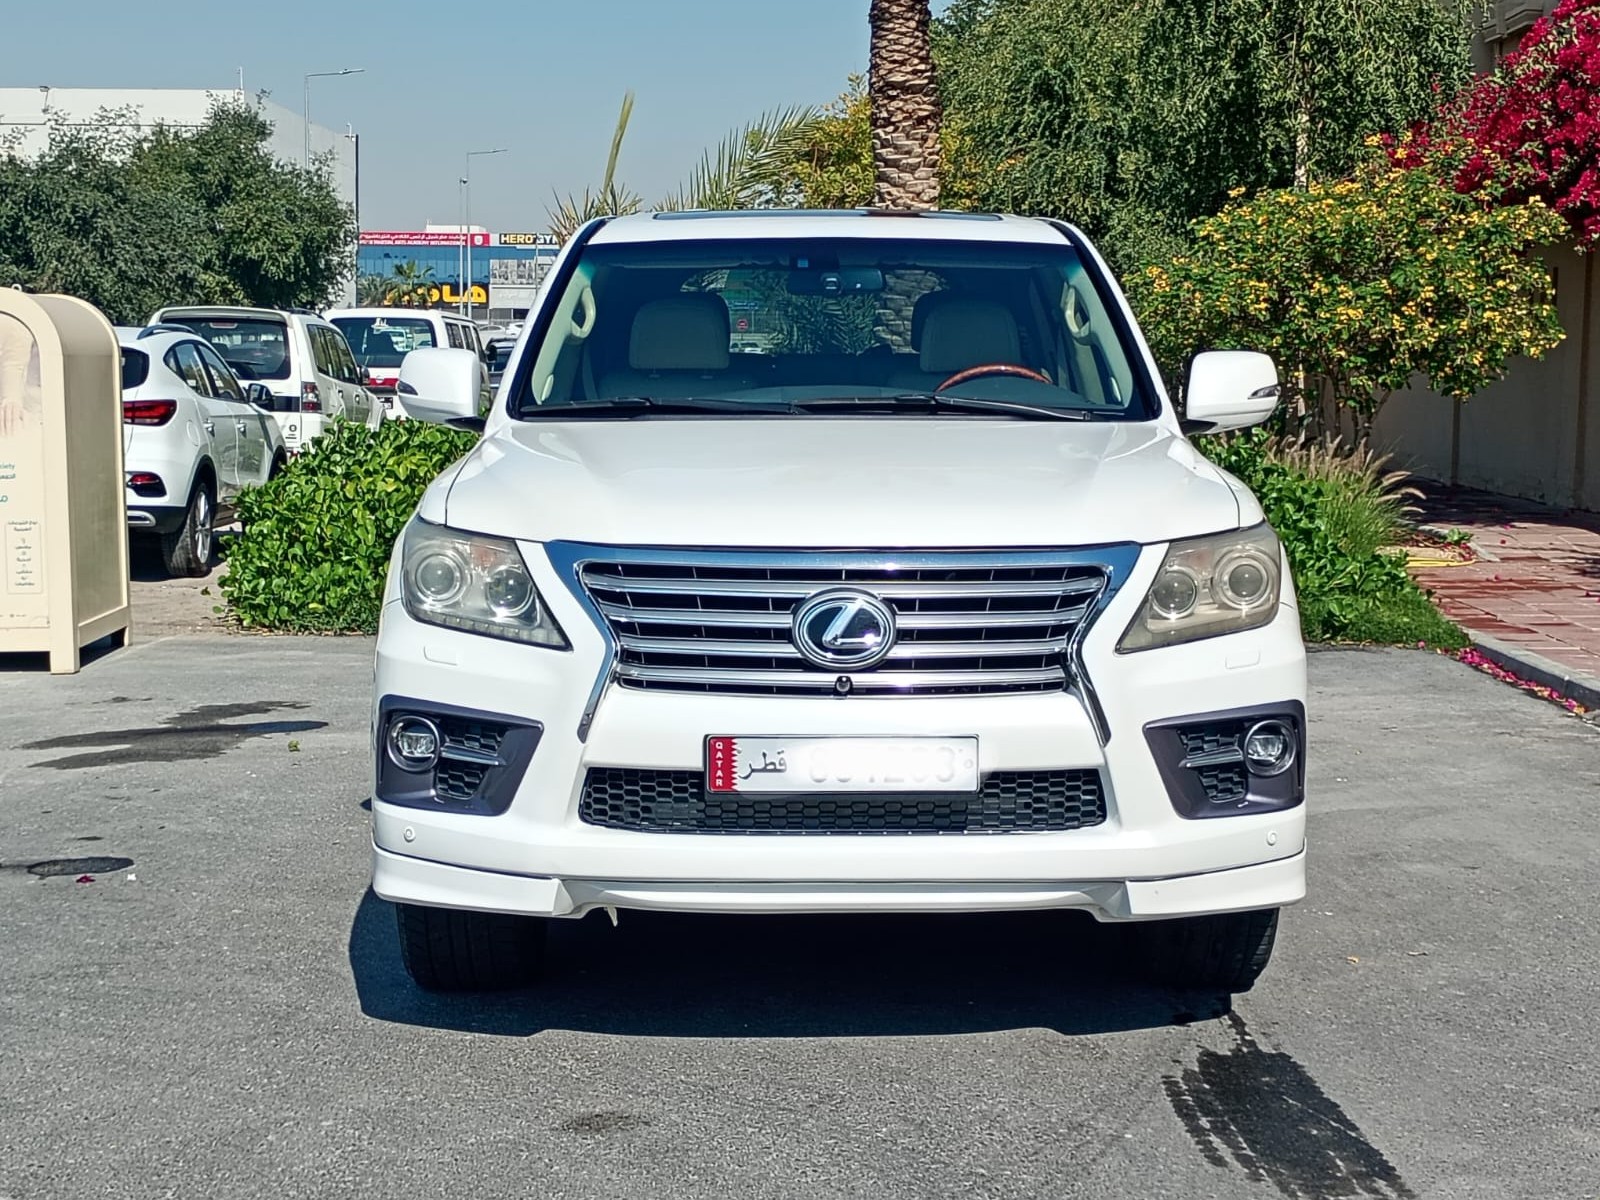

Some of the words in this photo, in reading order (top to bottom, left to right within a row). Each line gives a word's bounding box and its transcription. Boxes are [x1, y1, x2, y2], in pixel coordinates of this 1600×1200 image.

[501, 234, 533, 244] HERO
[715, 741, 724, 787] QATAR
[738, 749, 788, 780] قطر
